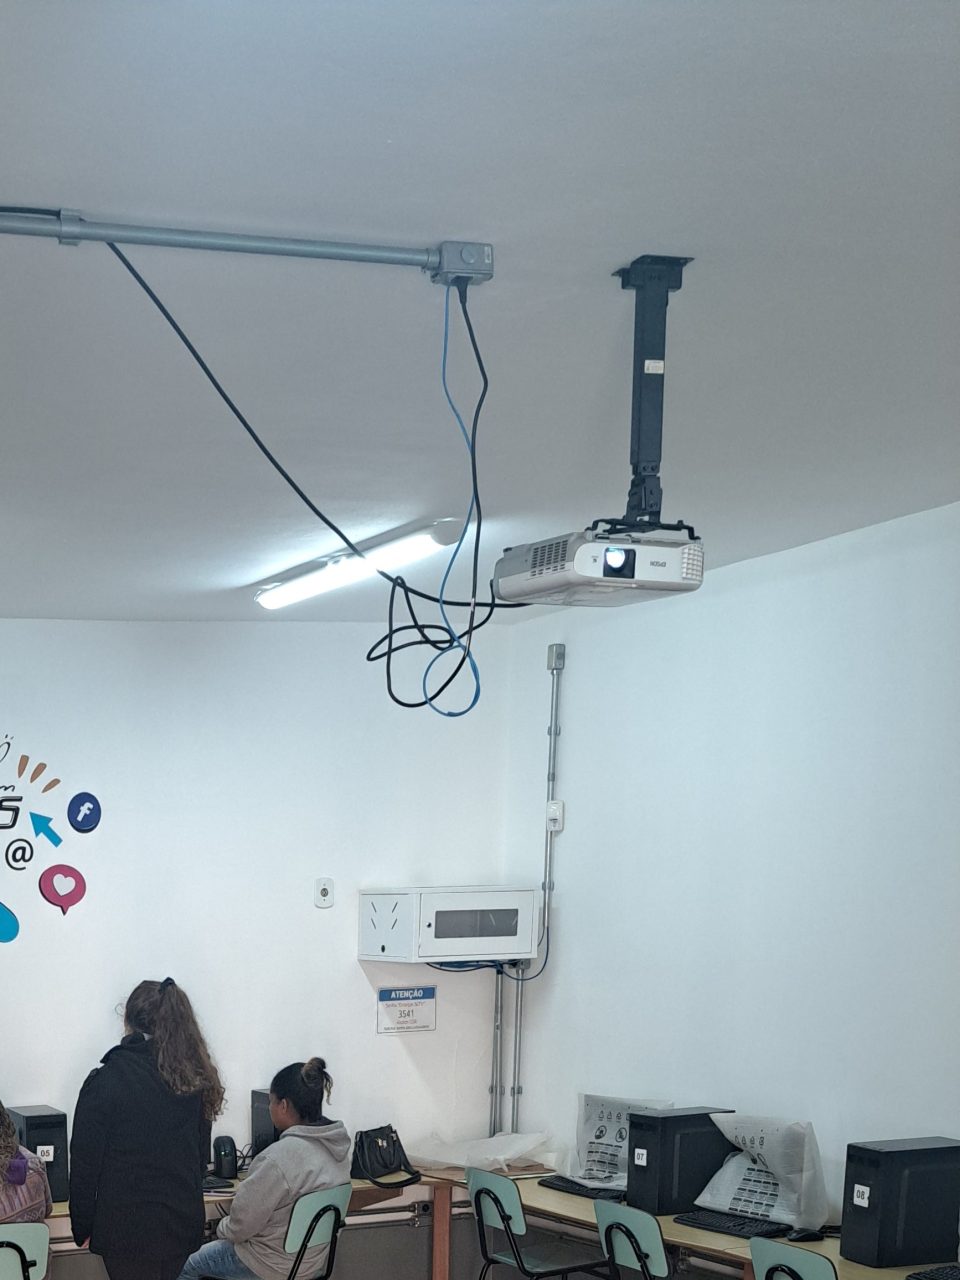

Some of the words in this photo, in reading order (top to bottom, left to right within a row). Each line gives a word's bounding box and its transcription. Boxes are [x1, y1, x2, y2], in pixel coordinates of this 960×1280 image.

[390, 988, 424, 999] ATENÇÃO
[40, 1149, 50, 1157] 05
[636, 1152, 645, 1161] 07
